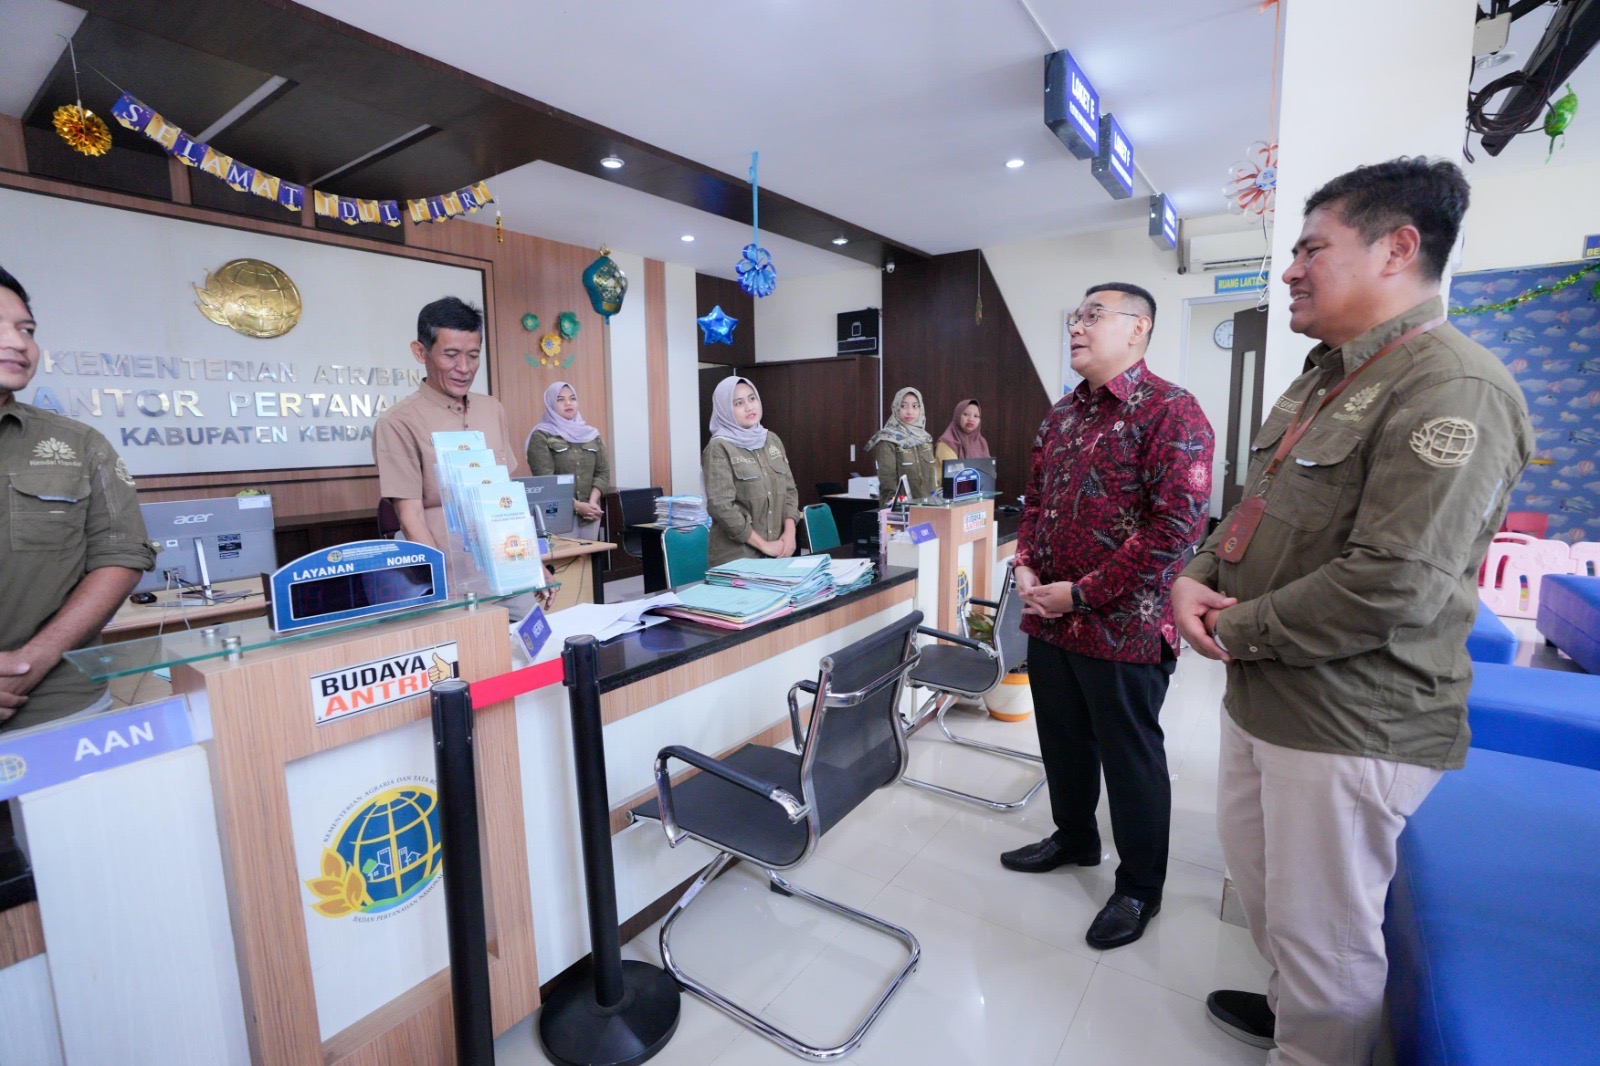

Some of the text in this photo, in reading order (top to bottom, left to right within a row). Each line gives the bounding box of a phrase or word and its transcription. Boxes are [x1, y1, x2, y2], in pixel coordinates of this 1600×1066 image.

[122, 104, 488, 222] SELAMAT IDUL FITRI
[1586, 248, 1600, 257] BE
[1218, 278, 1239, 289] RUANG
[43, 349, 422, 387] KEMENTERIAN ATR/BPN
[31, 386, 397, 418] ANTOR PERTANA
[121, 425, 373, 447] KABUPATEN KENDA
[525, 486, 545, 494] acer
[173, 513, 214, 525] acer
[293, 563, 355, 581] LAYANAN
[387, 554, 426, 566] NOMOR
[321, 655, 427, 697] BUDAYA
[325, 672, 429, 717] ANTRI
[74, 721, 154, 762] AAN
[323, 795, 363, 843] KEMENTERIAN
[365, 780, 395, 796] AGRARIA
[396, 775, 412, 783] DAN
[413, 775, 429, 783] TATA
[352, 914, 375, 923] BADAN
[376, 899, 418, 922] PERTANAHAN
